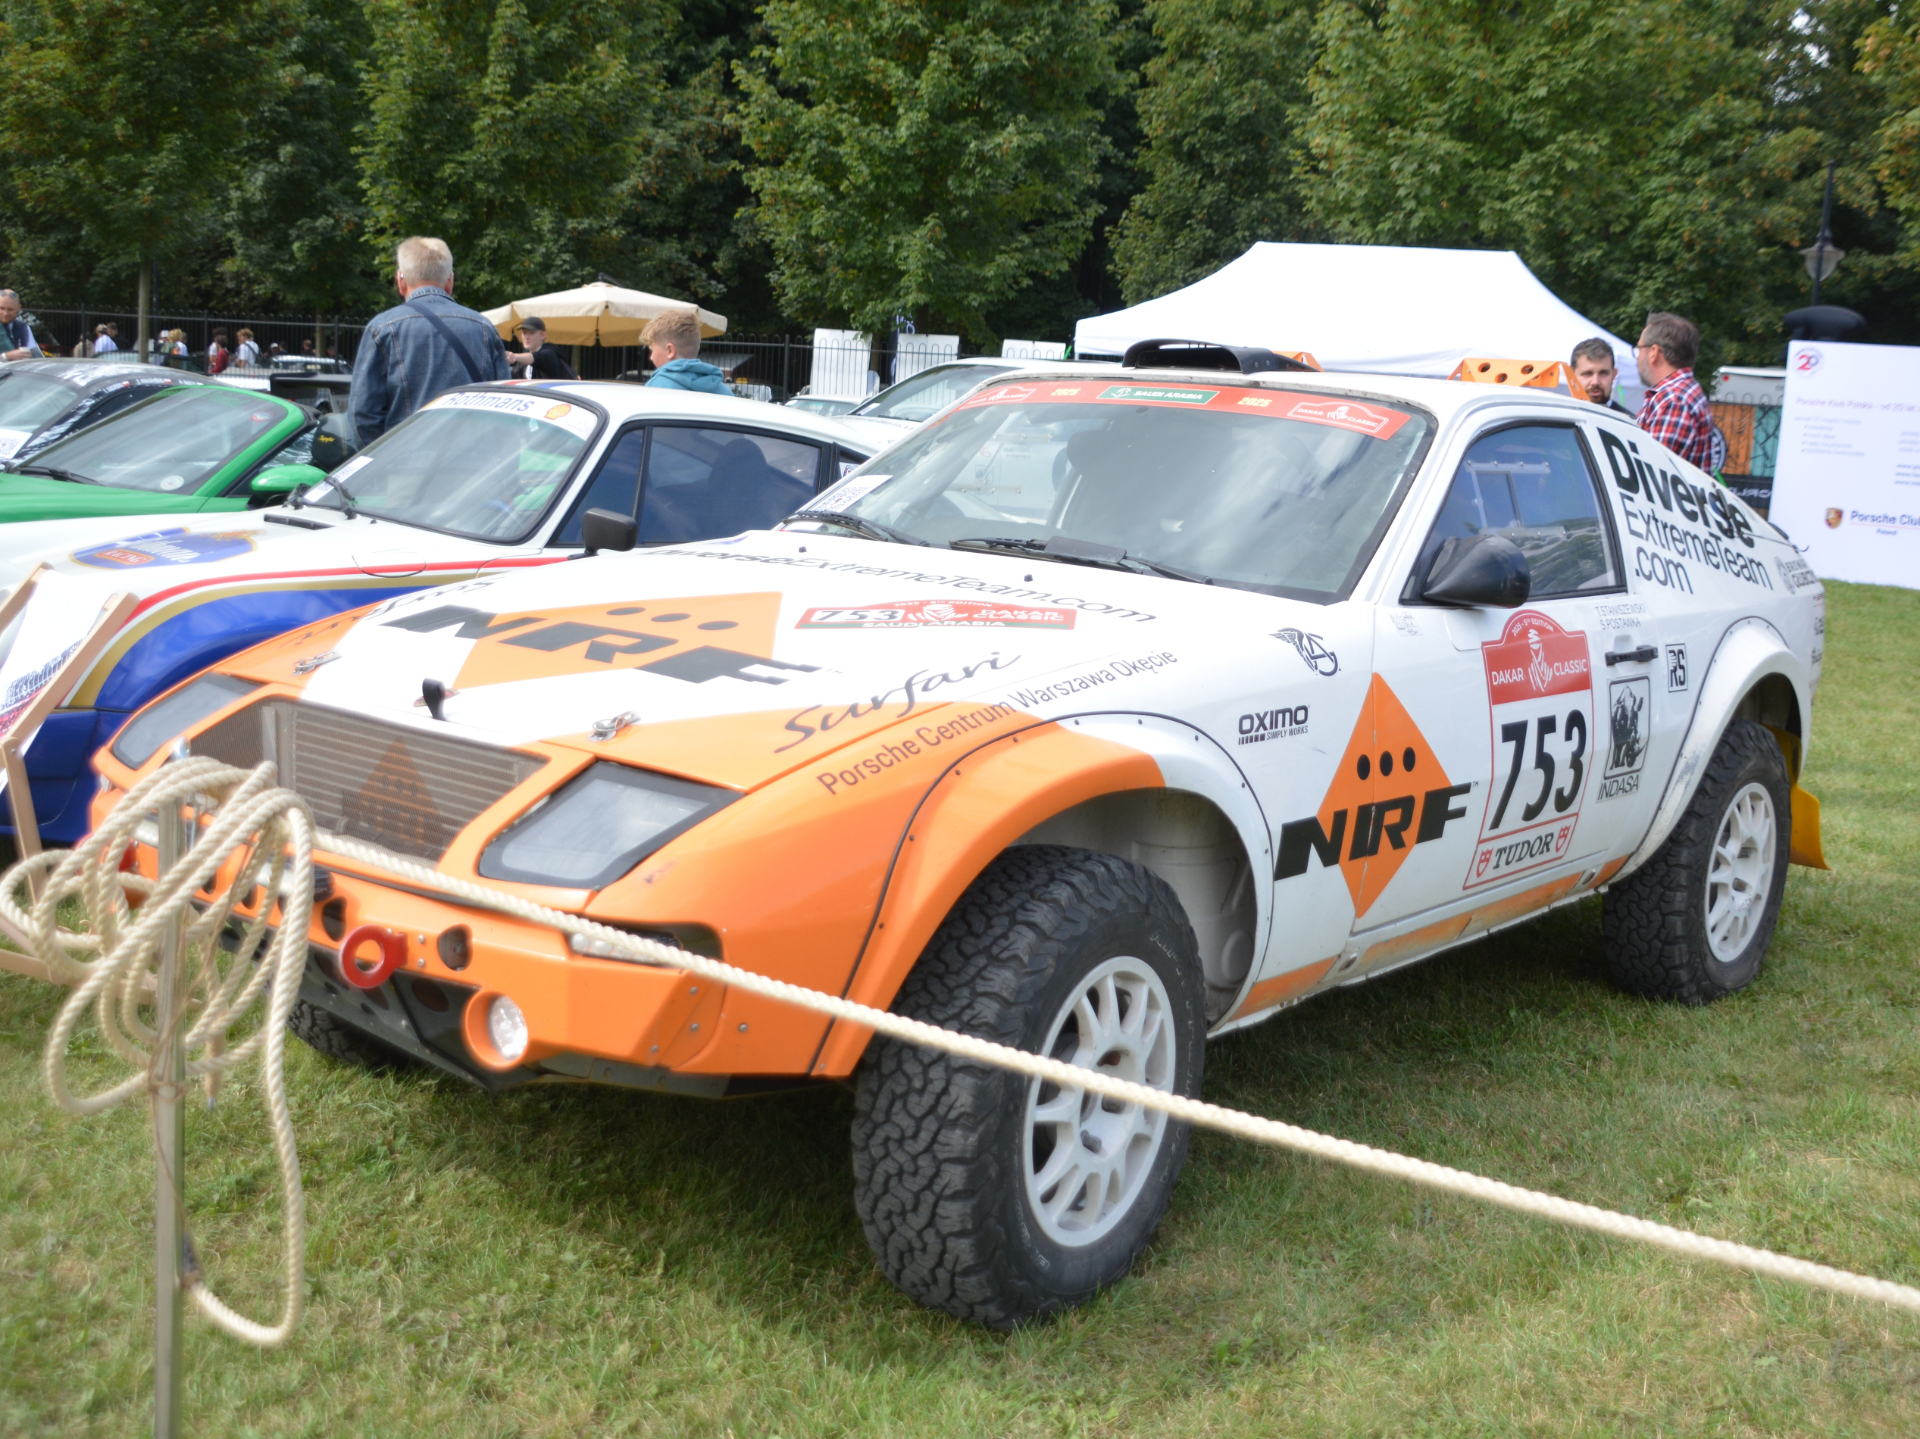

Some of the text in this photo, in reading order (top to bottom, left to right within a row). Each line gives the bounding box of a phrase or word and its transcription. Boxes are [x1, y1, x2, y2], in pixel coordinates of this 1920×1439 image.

[442, 391, 535, 412] Rothmans
[1051, 388, 1081, 396] 2025
[1133, 390, 1203, 400] SAUDI ARABIA
[1238, 397, 1272, 407] 2025
[1297, 408, 1379, 428] DAKAR CLASSIC
[1597, 427, 1755, 549] Diverse
[1851, 510, 1896, 525] Porsche
[1619, 491, 1774, 591] ExtremeTeam
[1635, 546, 1694, 595] .com
[816, 609, 900, 622] 753
[949, 600, 993, 608] EDITION
[862, 619, 1005, 629] SAUDI ARABIA
[1531, 618, 1554, 632] EDITION
[377, 604, 825, 687] NRF
[1491, 659, 1588, 685] DAKAR CLASSIC
[774, 651, 1021, 754] Surfari
[816, 650, 1178, 795] Porsche Centrum Warszawa Okęcie
[1238, 704, 1309, 735] OXIMO
[1266, 725, 1309, 741] SIMPLY WORKS
[1488, 708, 1587, 831] 753
[1598, 774, 1640, 801] INDASA
[1274, 781, 1472, 882] NRF
[1493, 832, 1555, 870] TUDOR
